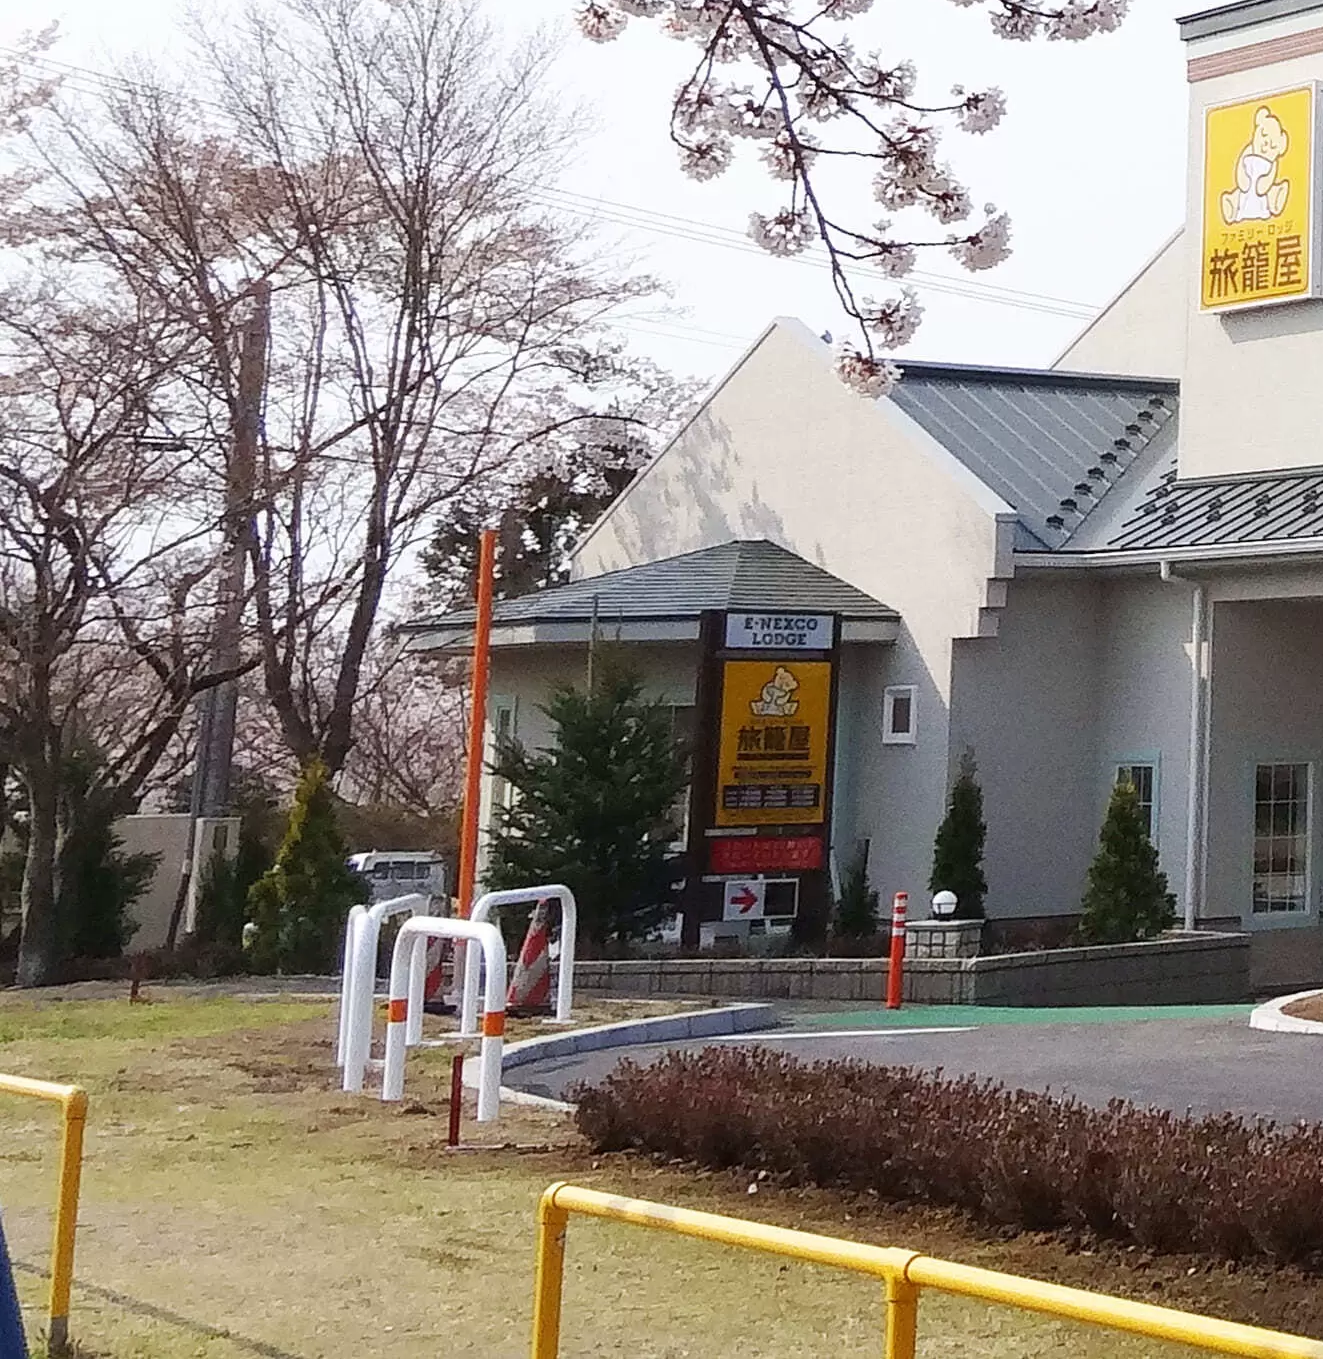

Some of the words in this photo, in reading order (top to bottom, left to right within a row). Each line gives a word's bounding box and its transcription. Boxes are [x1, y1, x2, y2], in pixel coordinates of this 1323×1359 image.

[1221, 227, 1263, 245] ファミリー
[1209, 234, 1302, 298] 旅籠屋
[751, 632, 807, 646] LODGE
